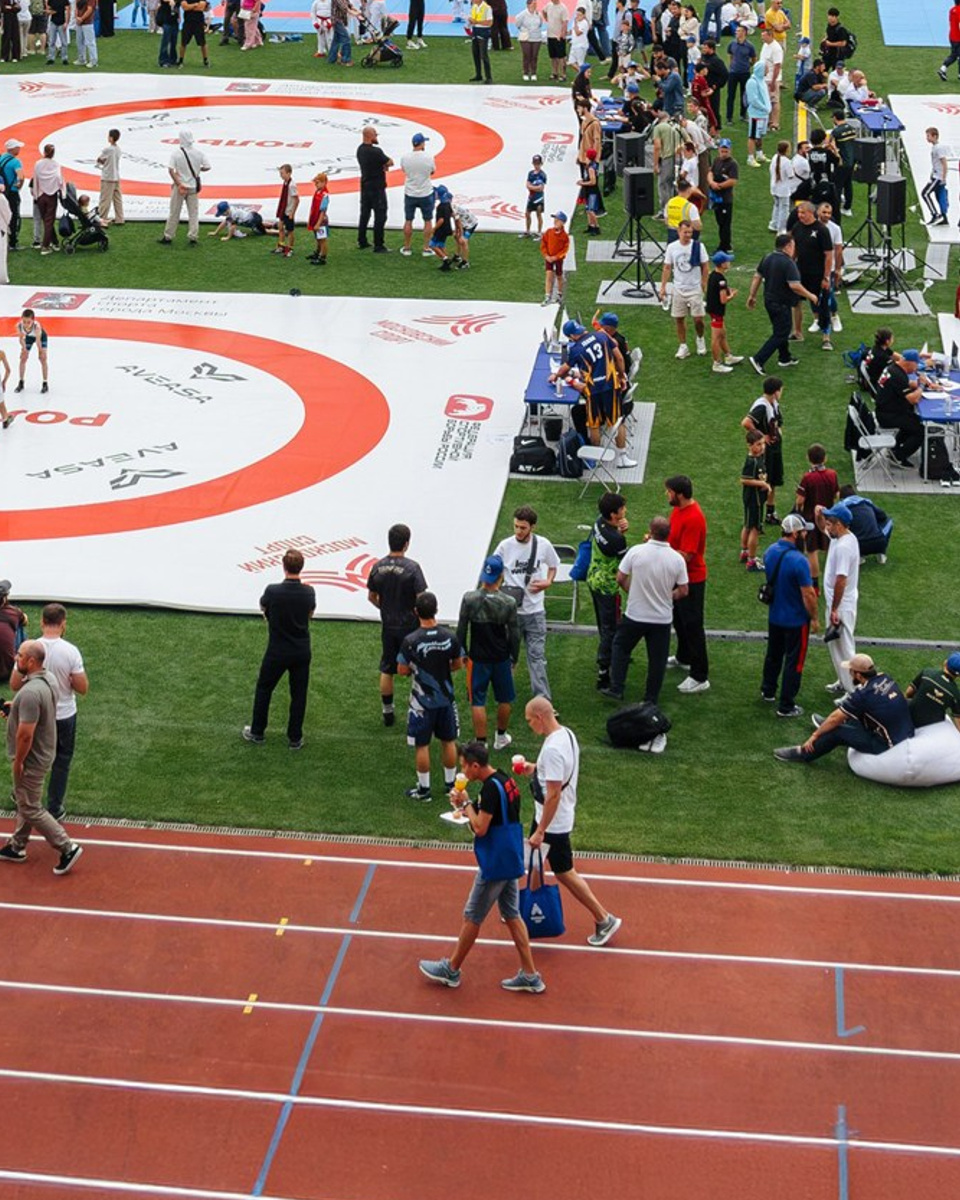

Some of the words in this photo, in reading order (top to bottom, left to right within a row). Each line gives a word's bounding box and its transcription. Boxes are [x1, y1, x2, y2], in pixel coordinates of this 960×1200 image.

[585, 343, 603, 363] 13
[115, 365, 212, 404] AVEASA
[25, 442, 178, 478] AVEASA
[237, 536, 369, 573] МОСКОСКИЙ
[254, 534, 317, 554] СПОРТ
